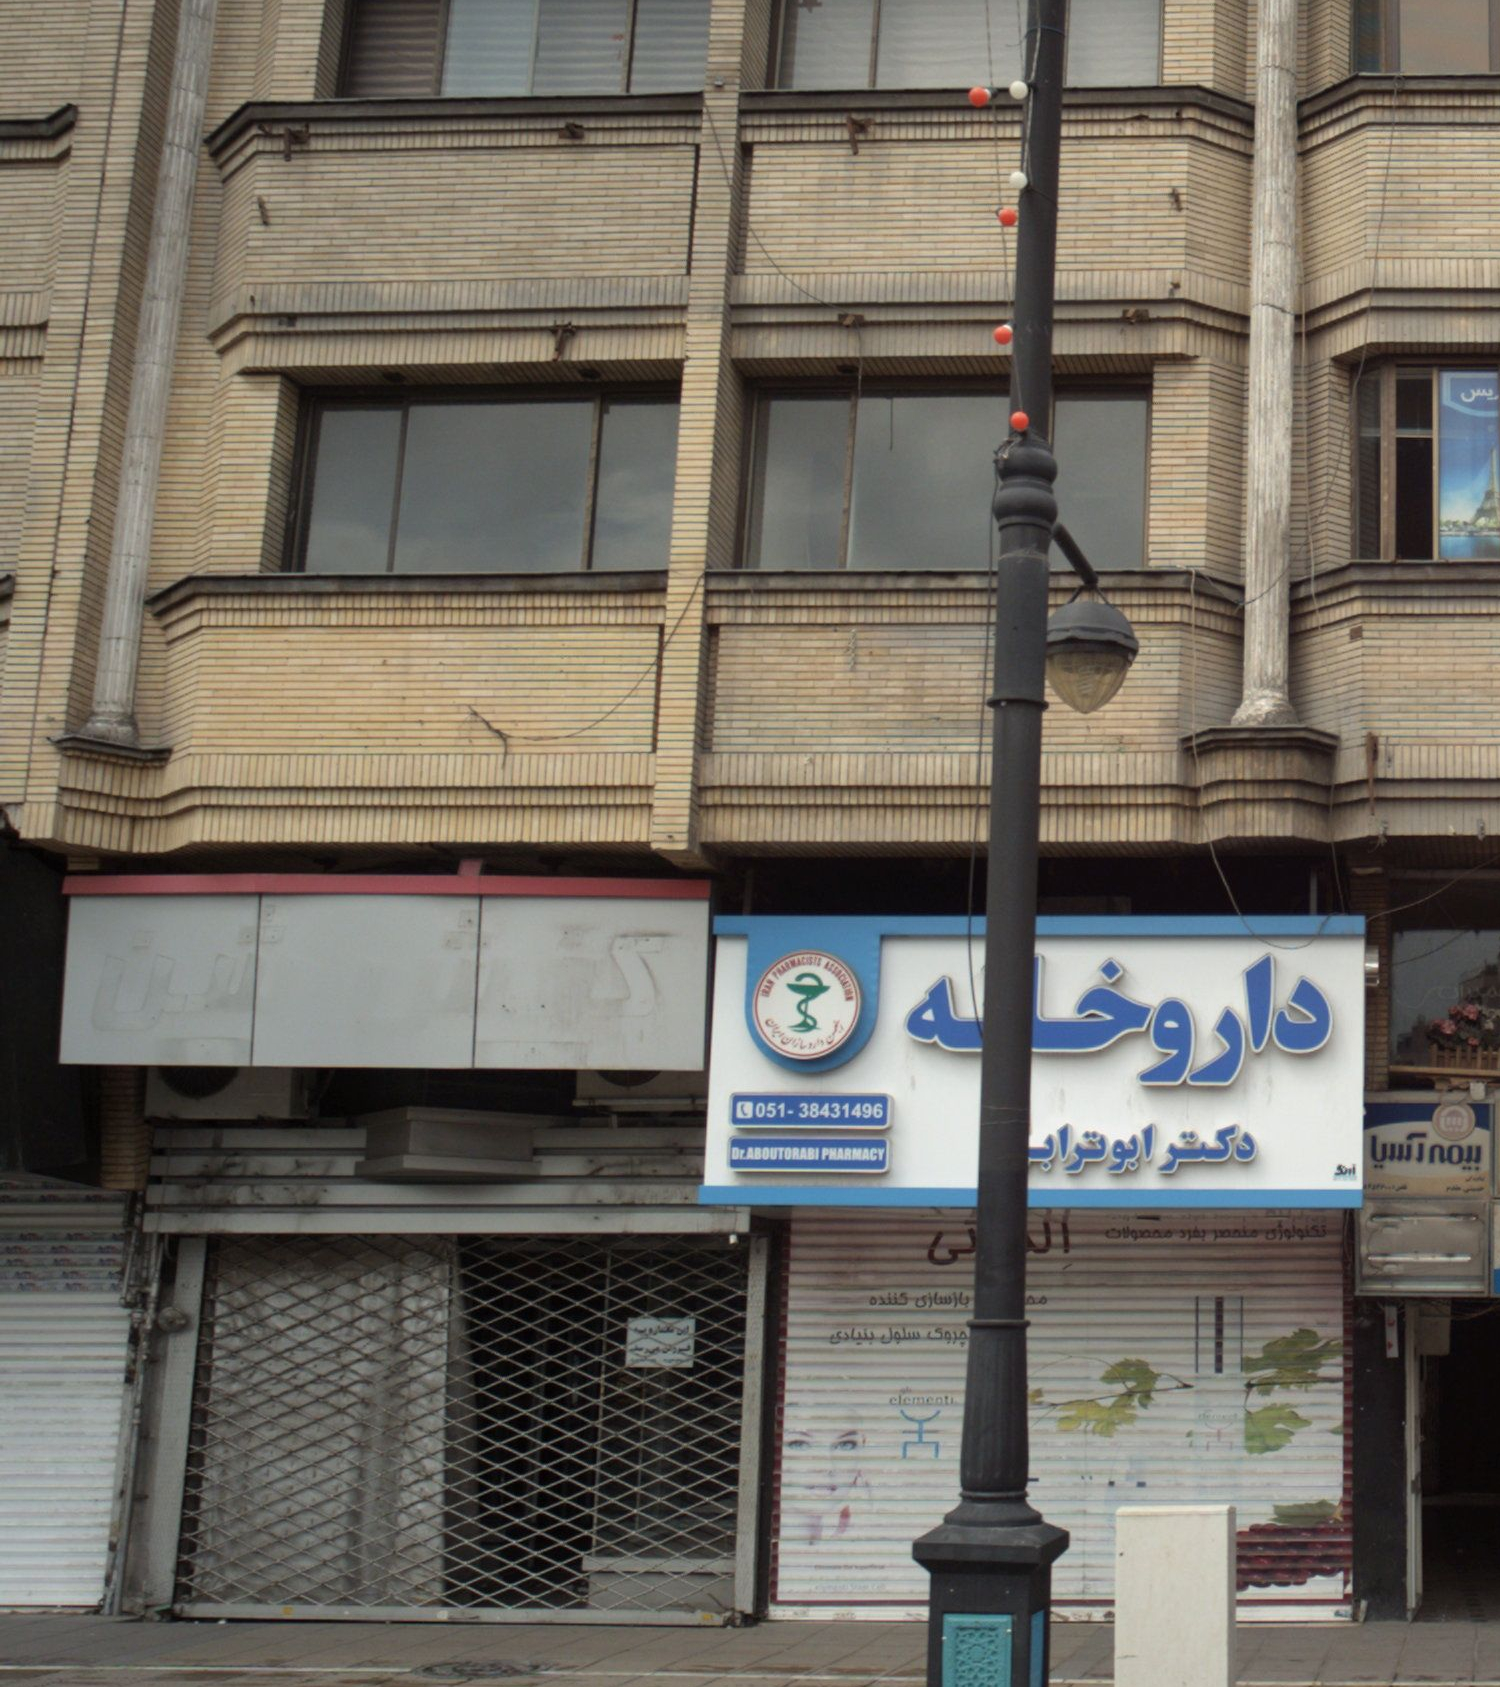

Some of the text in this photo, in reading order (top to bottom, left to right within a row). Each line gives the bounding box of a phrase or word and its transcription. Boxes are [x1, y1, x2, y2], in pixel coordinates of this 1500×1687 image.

[772, 956, 823, 980] PHARMACISTS
[904, 953, 1334, 1086] داروخاه
[755, 1102, 884, 1119] 051- 38431496
[731, 1147, 886, 1161] Dr.ABOUTORABI PHARMACY
[1028, 1123, 1259, 1174] دکتر ابوتراب
[1370, 1132, 1482, 1171] بیمه آسیا
[1104, 1223, 1328, 1241] تکنولوژی منحصر بفرد محصولات
[869, 1291, 971, 1309] بازسازی کننده
[829, 1327, 875, 1346] بنیادی
[880, 1327, 922, 1346] سلول
